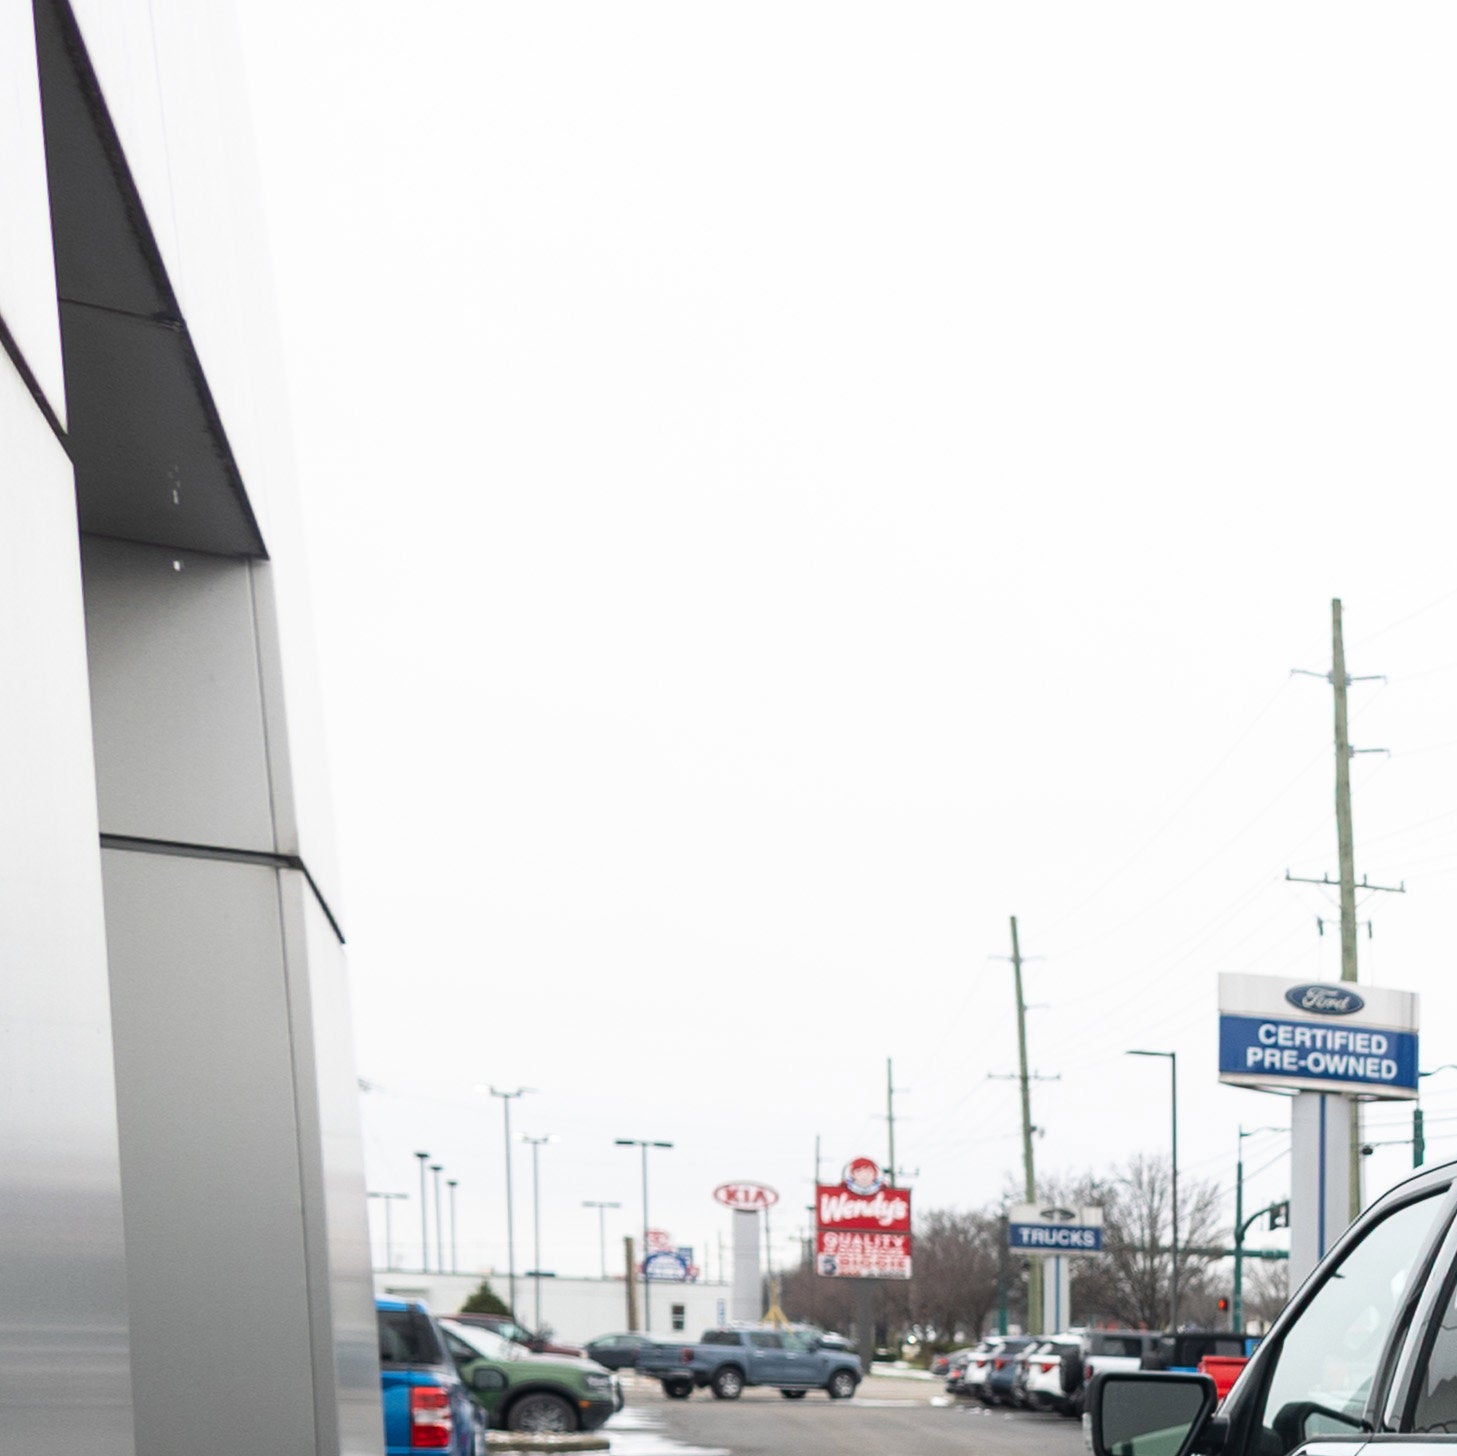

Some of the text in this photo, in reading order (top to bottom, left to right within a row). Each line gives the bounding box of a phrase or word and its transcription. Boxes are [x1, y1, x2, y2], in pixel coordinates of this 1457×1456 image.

[1301, 986, 1350, 1012] Ford
[1258, 1023, 1388, 1055] CERTIFIED
[1246, 1046, 1398, 1080] PRE-OWNED
[725, 1186, 767, 1203] KIA
[820, 1191, 908, 1226] Wendy's
[823, 1232, 905, 1248] QUALITY
[1018, 1226, 1095, 1247] TRUCKS
